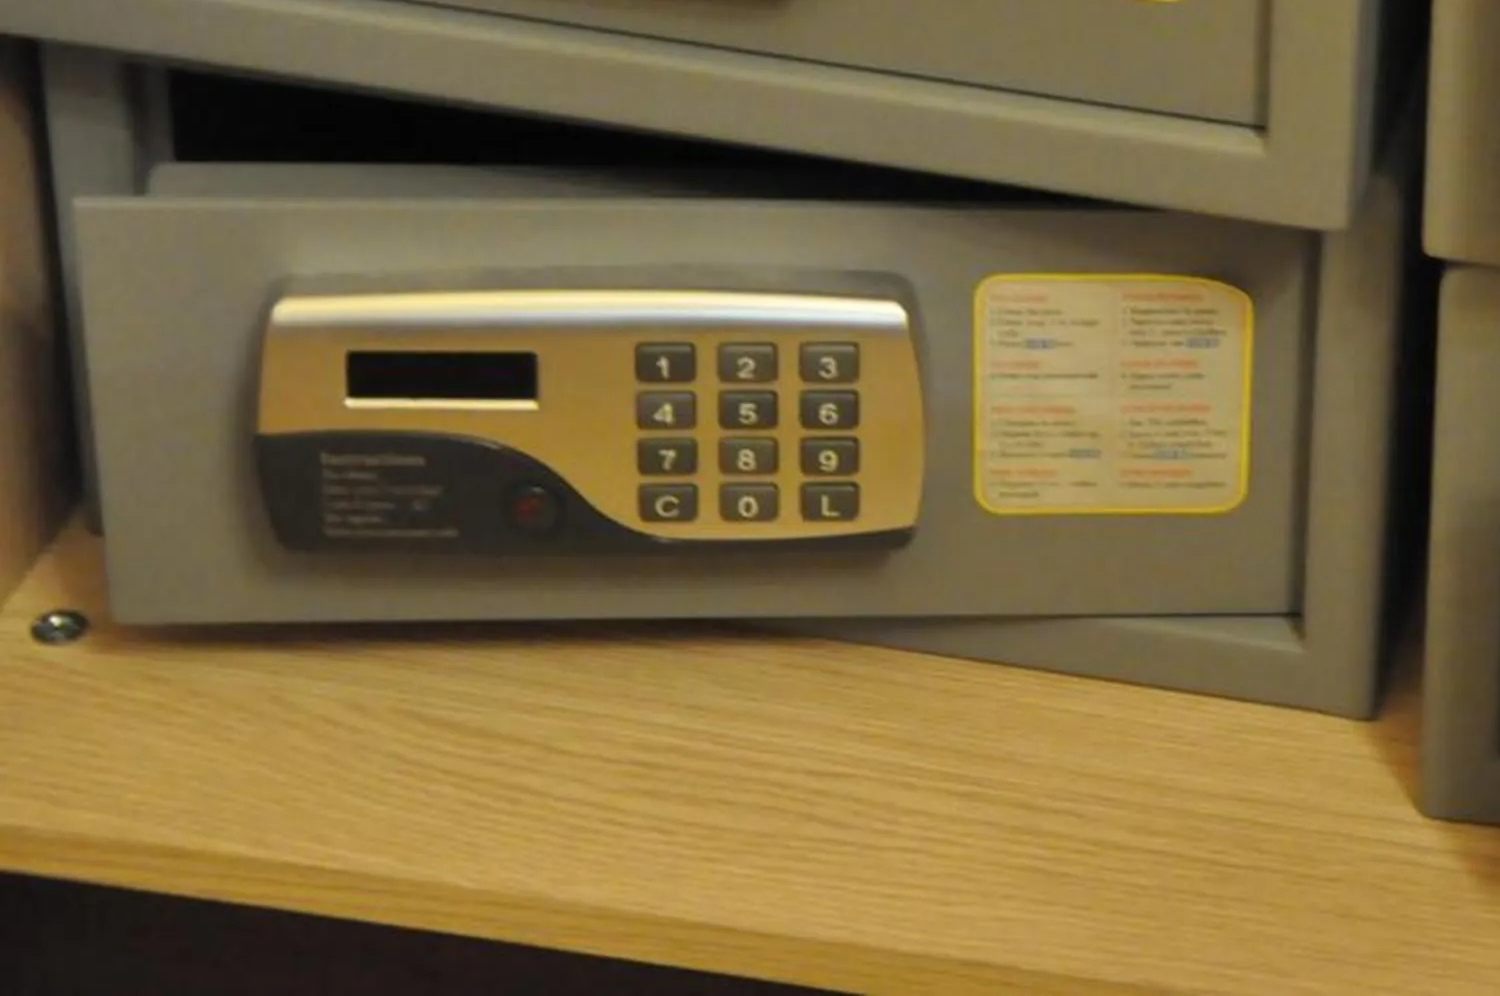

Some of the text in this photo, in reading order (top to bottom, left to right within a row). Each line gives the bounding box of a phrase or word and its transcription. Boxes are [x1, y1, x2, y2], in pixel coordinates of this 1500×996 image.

[655, 355, 839, 380] 1 2 3
[652, 402, 839, 426] 4 5 6
[658, 448, 839, 472] 7 8 9
[654, 494, 840, 518] C 0 L
